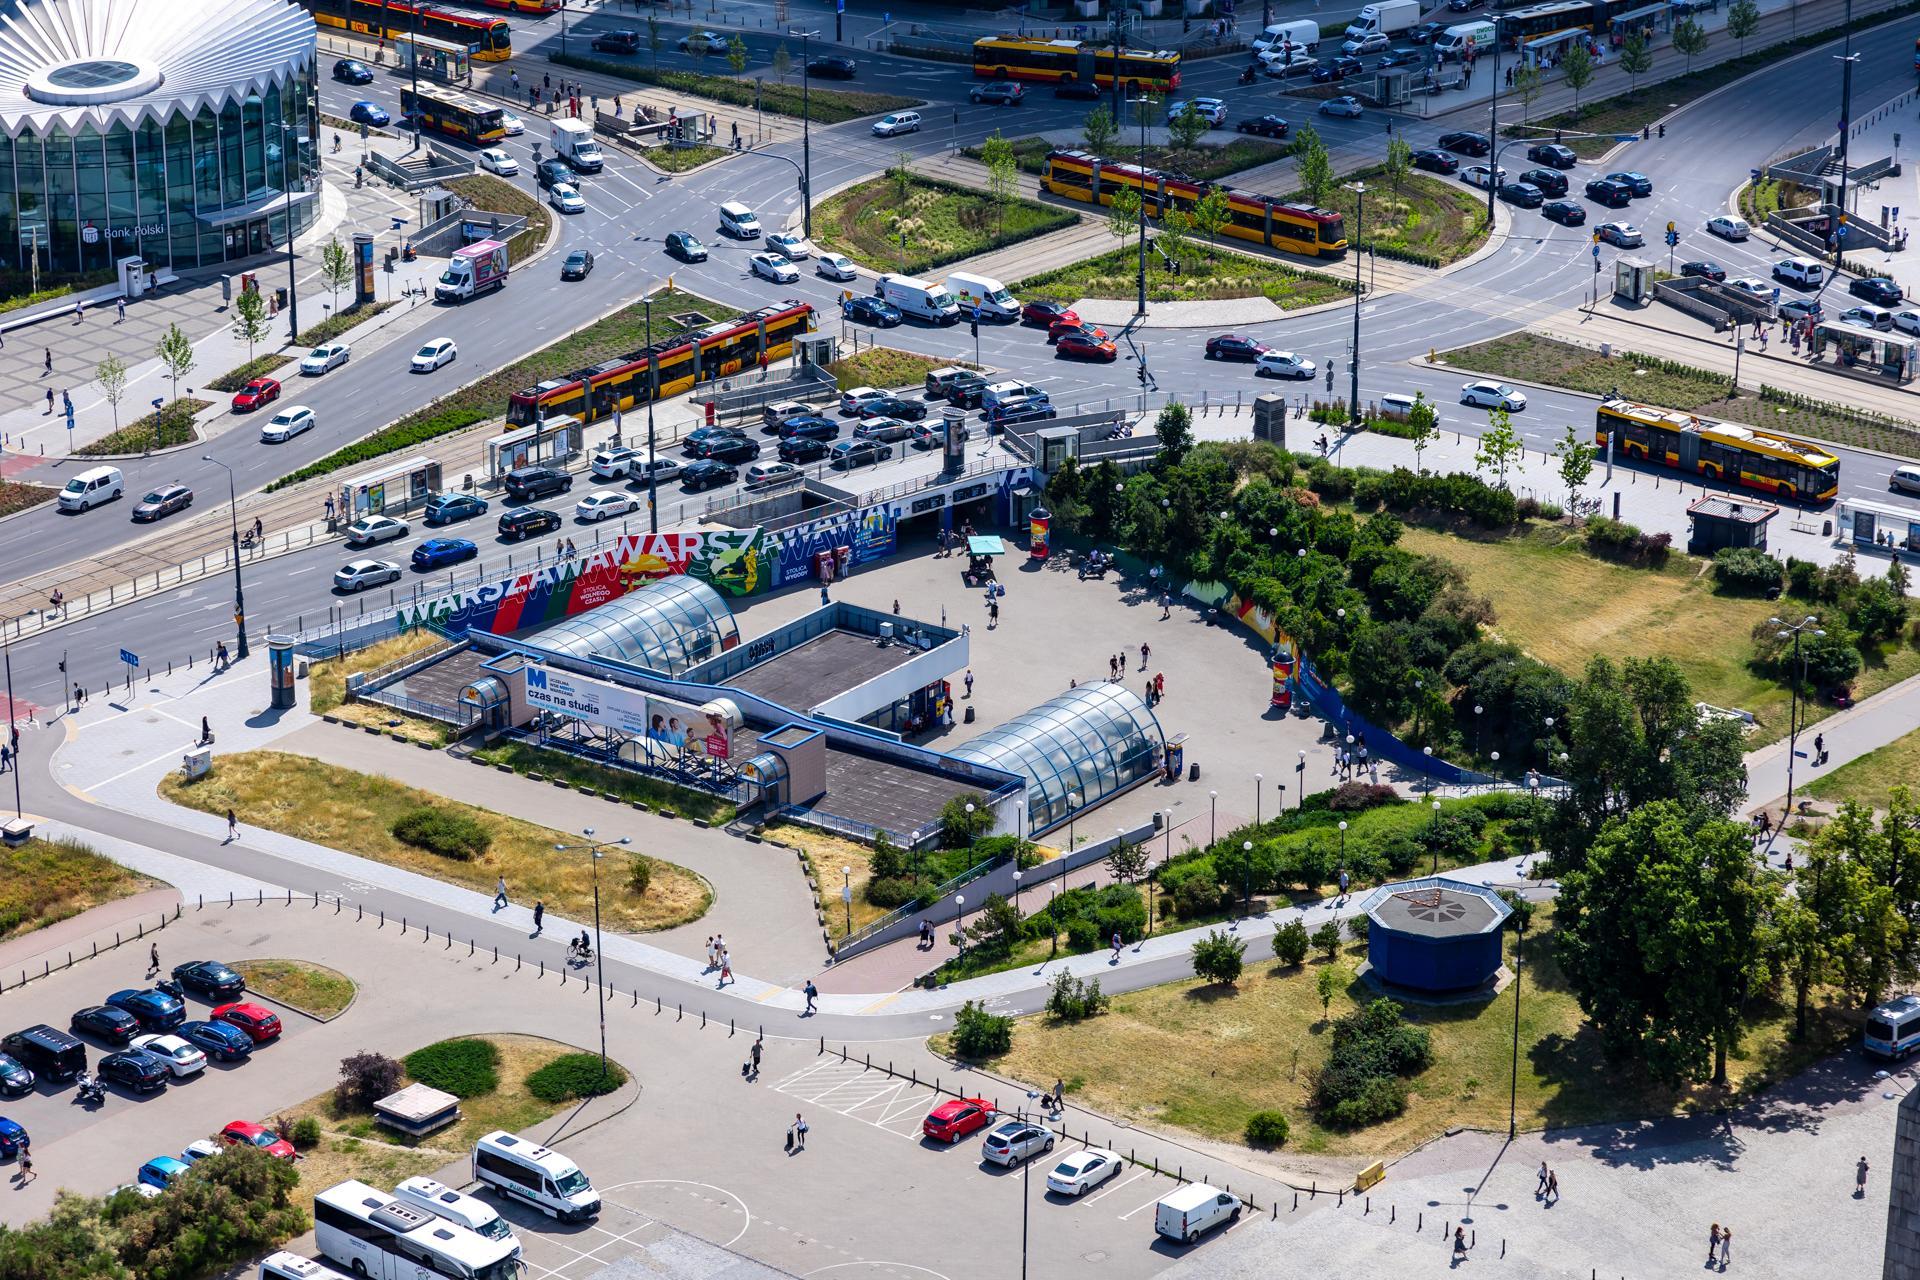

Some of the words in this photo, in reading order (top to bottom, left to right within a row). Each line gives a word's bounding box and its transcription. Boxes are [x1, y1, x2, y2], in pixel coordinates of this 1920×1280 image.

[104, 226, 130, 239] Bank
[134, 223, 164, 236] Polski
[580, 590, 610, 600] WOLNEGO
[583, 585, 606, 594] STOLICA
[585, 596, 604, 604] CZASU
[527, 667, 547, 689] M
[528, 689, 551, 702] czas
[553, 696, 566, 706] na
[568, 700, 600, 715] studia
